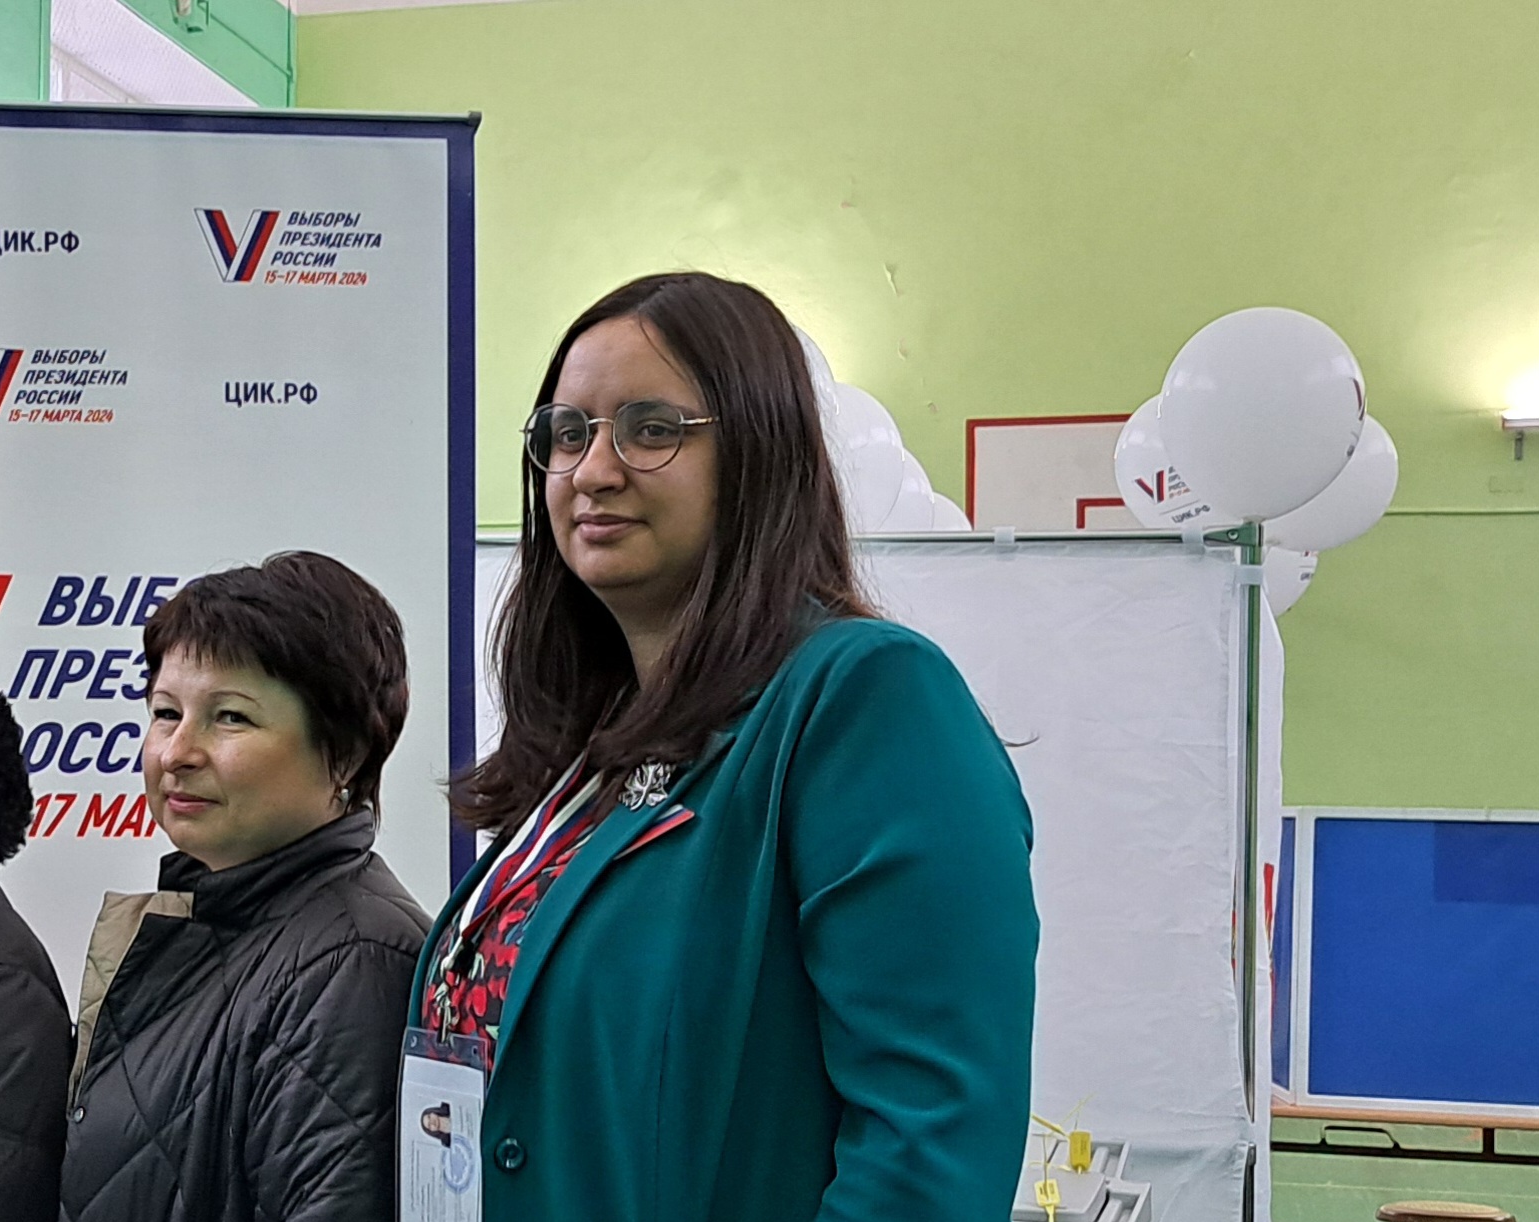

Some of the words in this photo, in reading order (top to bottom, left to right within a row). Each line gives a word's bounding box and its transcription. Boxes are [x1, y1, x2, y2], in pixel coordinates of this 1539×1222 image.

[287, 211, 362, 228] ВЫБОРЫ
[279, 231, 382, 250] ПРЕЗИДЕНТА
[271, 251, 337, 268] РОССИИ
[297, 271, 337, 285] МАРТА
[338, 272, 368, 286] 2024
[30, 349, 106, 366] ВЫБОРЫ
[22, 369, 129, 387] ПРЕЗИДЕНТА
[14, 389, 83, 406] РОССИИ
[224, 382, 318, 407] ЦИК.РФ
[42, 409, 82, 423] МАРТА
[84, 410, 115, 424] 2024
[38, 575, 184, 627] ВЫБ
[20, 722, 144, 774] ОСС
